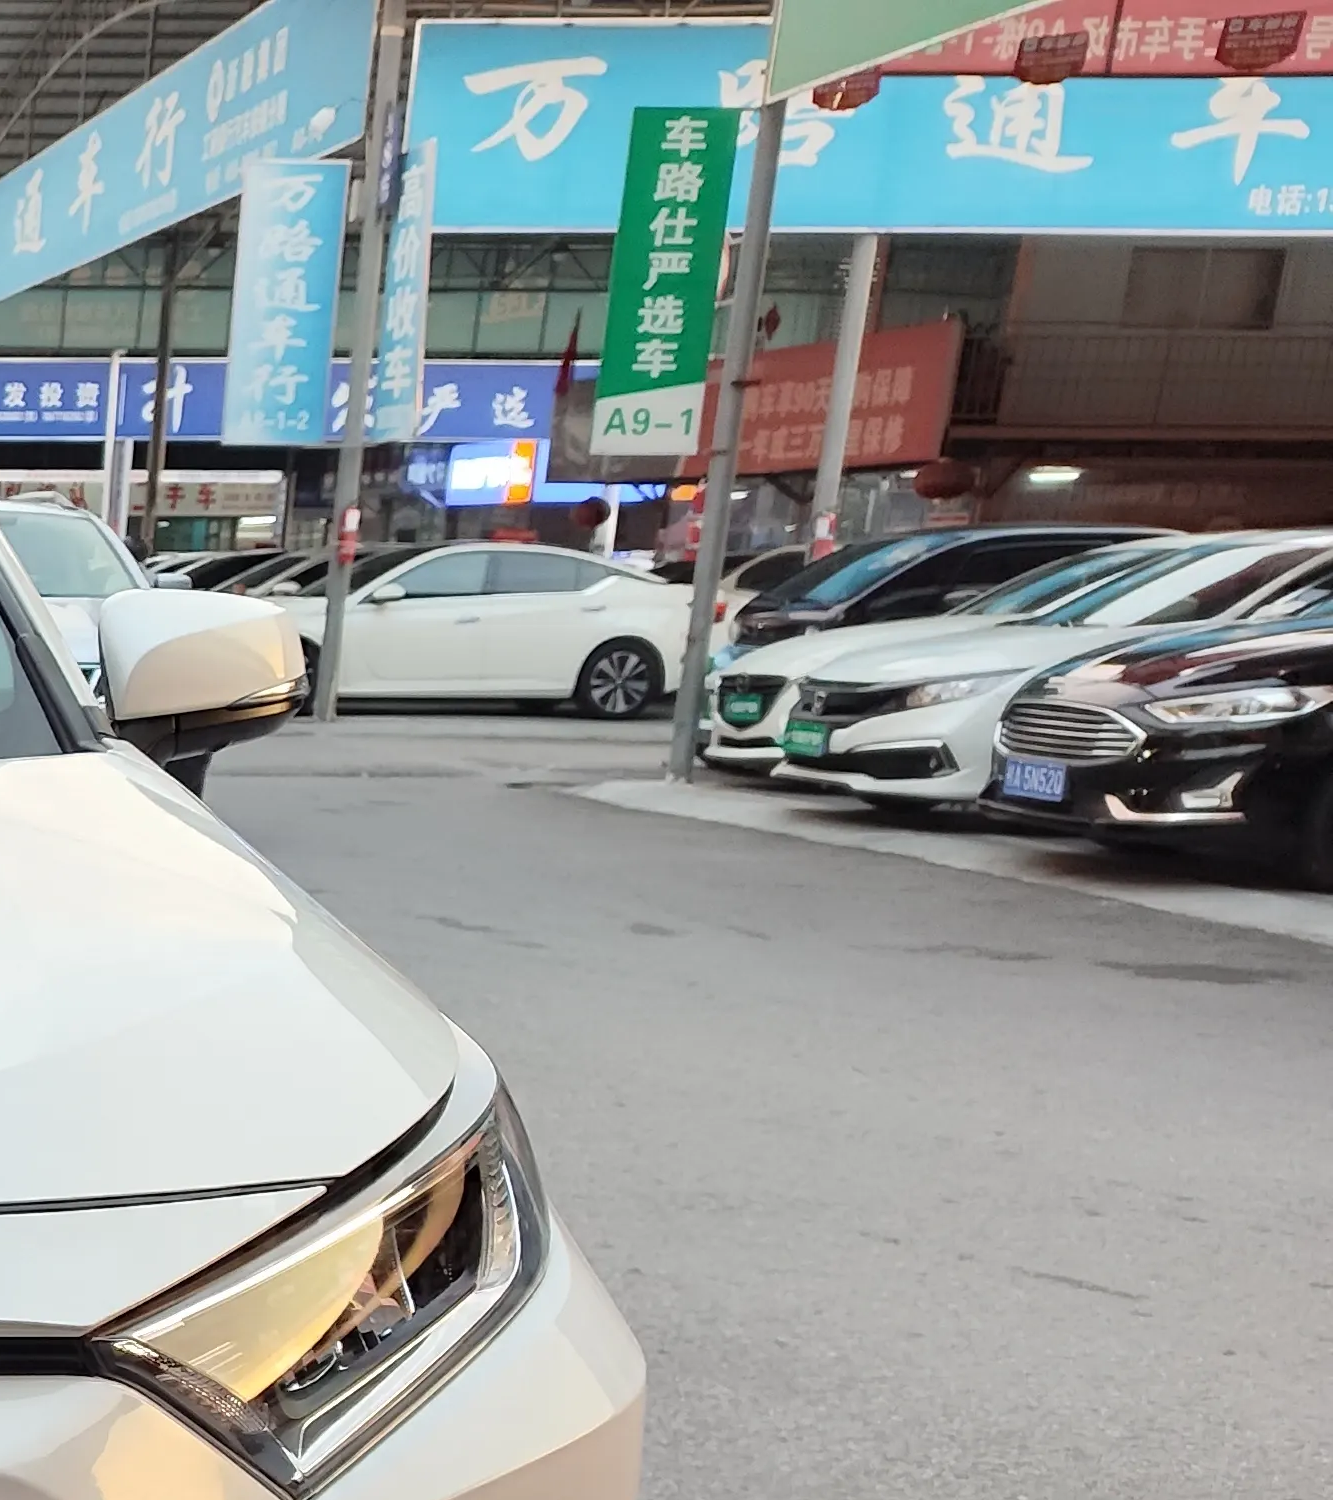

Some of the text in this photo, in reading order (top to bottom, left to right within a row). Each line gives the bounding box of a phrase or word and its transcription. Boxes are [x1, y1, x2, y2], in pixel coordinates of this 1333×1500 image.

[1248, 184, 1333, 216] 电话:1
[632, 115, 709, 379] 车路仕严选车
[602, 407, 694, 436] A9-1
